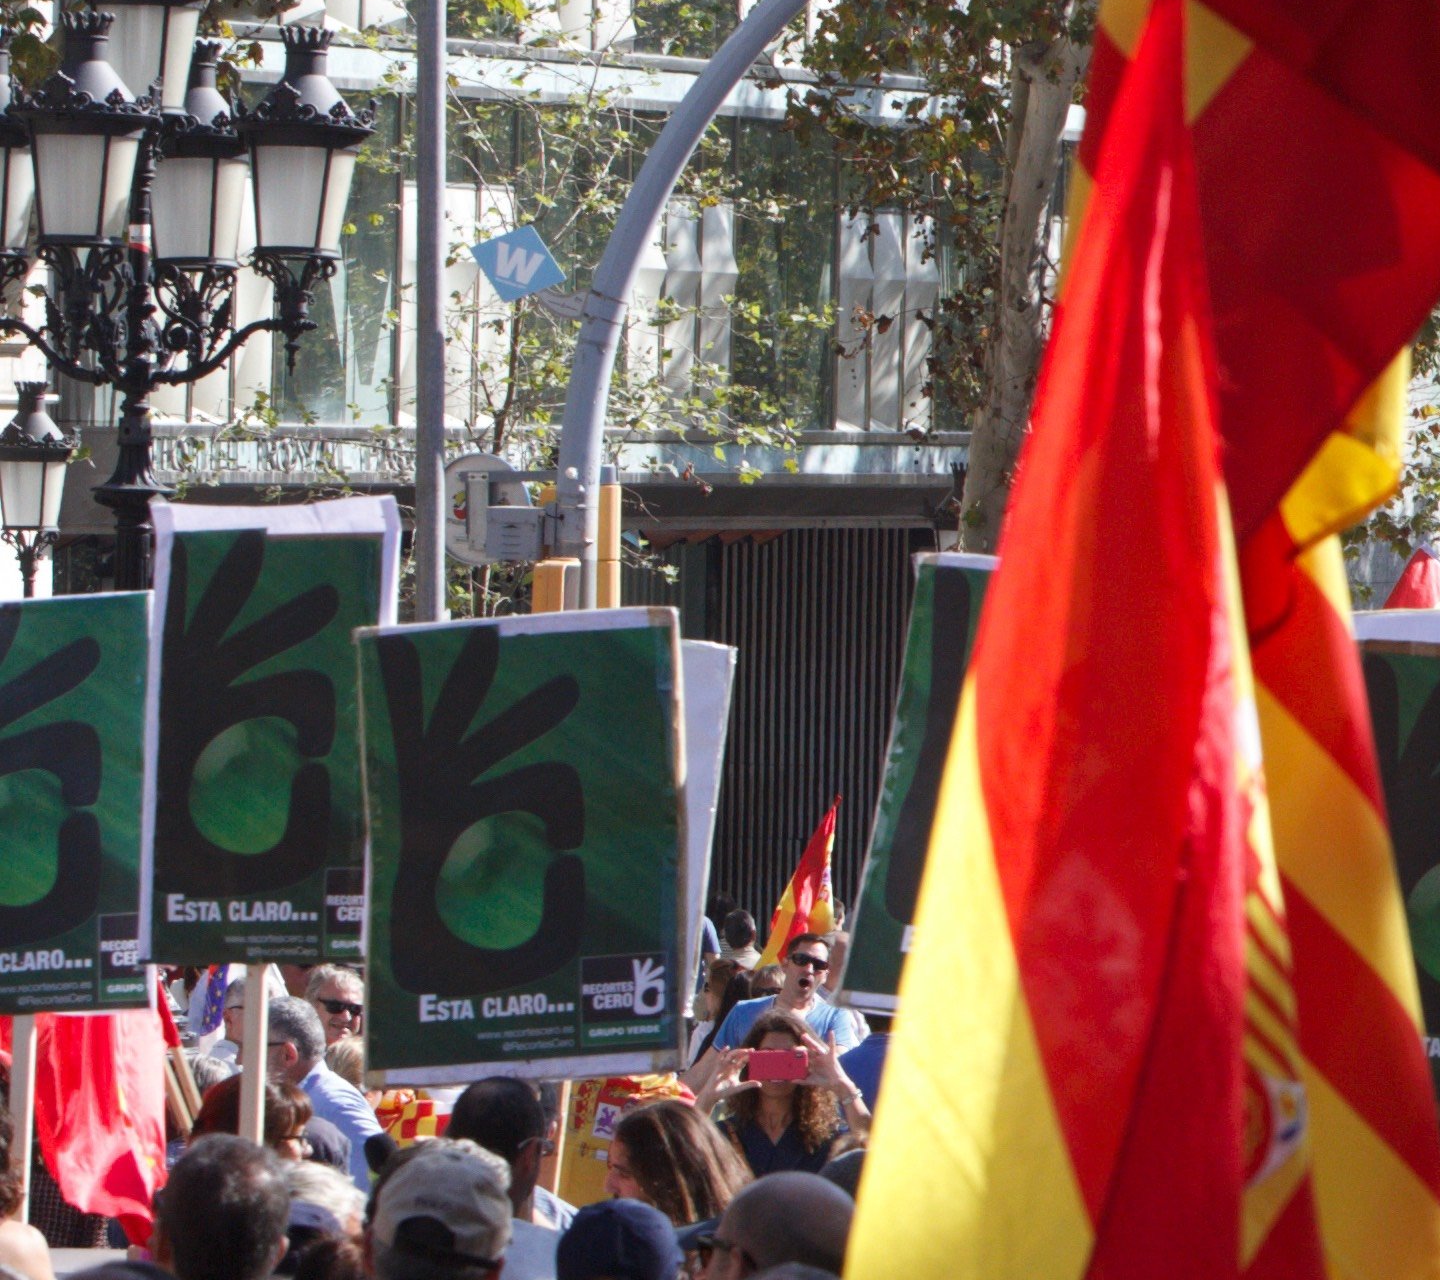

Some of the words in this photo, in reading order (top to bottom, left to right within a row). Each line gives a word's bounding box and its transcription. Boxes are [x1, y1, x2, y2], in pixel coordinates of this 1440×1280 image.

[495, 240, 546, 285] W
[581, 980, 635, 996] RECORTES
[592, 991, 634, 1011] CERO
